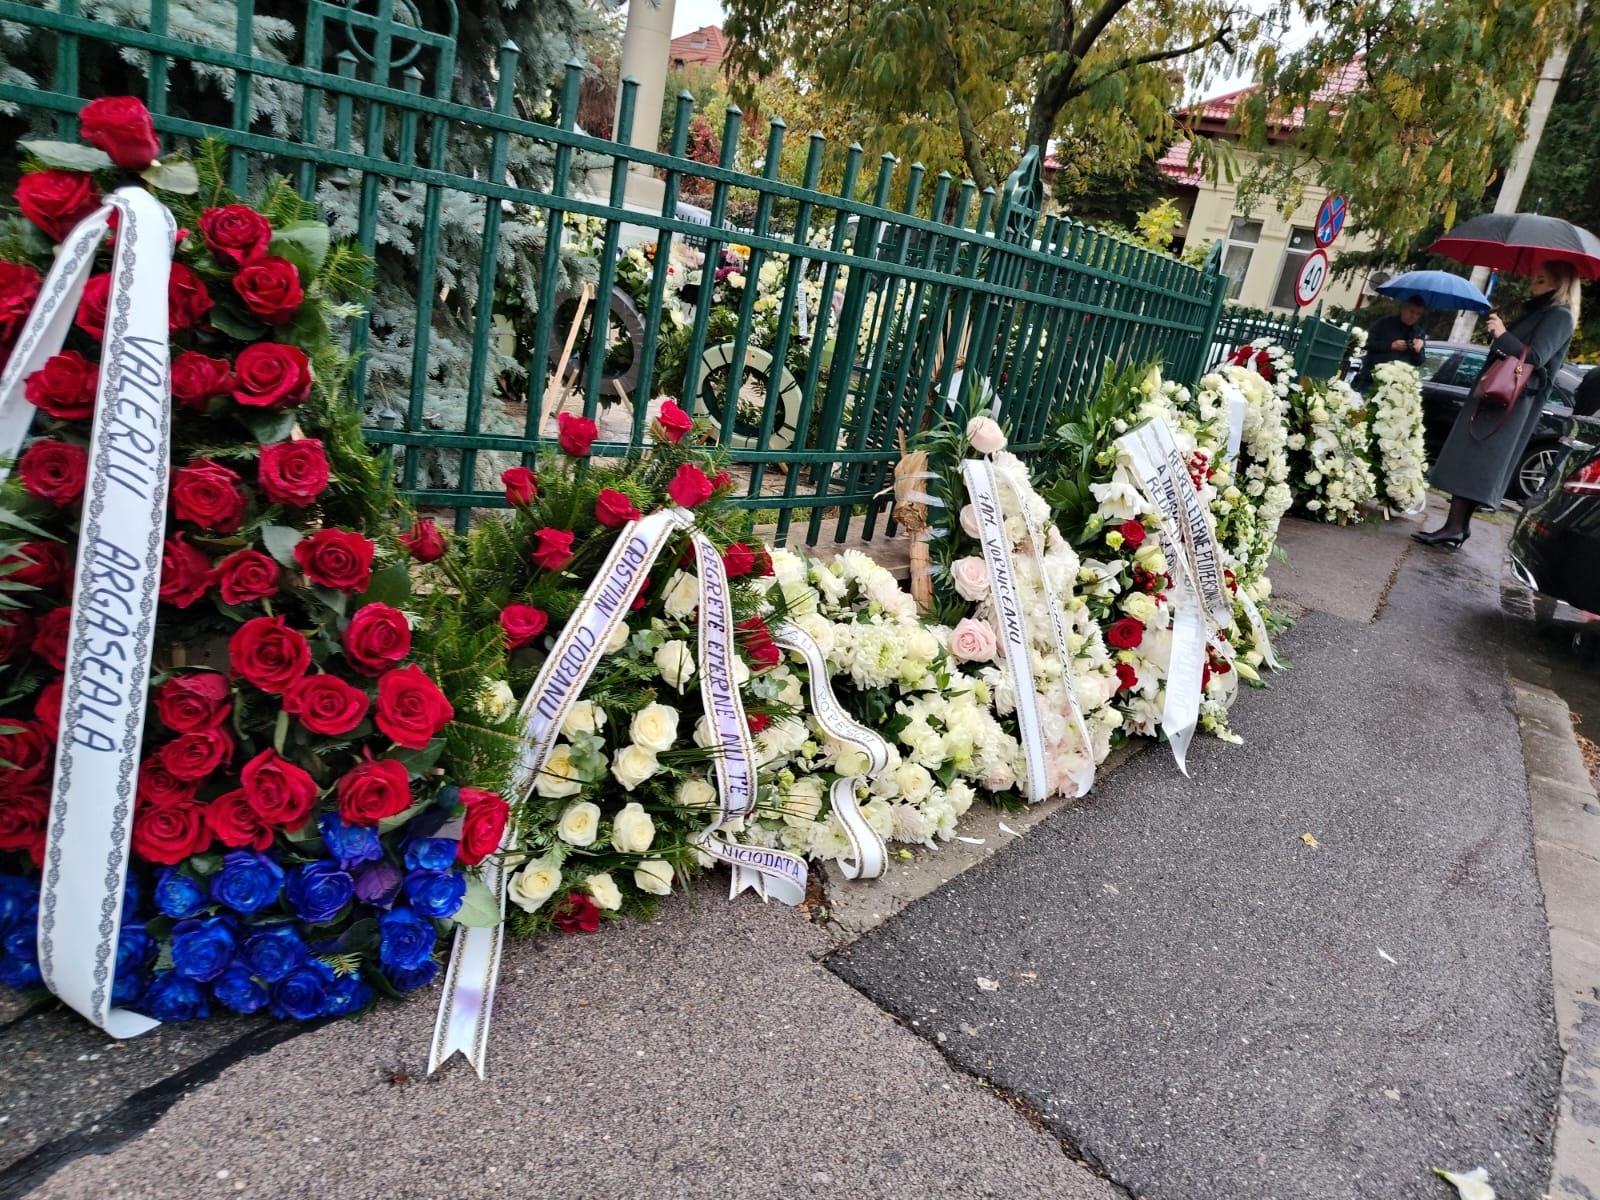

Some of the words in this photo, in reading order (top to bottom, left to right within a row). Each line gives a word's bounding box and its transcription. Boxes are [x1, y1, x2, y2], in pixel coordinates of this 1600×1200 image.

[1304, 264, 1322, 291] 40
[107, 335, 164, 500] VALERIU
[594, 537, 648, 618] CRISTIAN
[701, 541, 725, 633] REGRETE
[537, 625, 596, 720] CIOBANU
[708, 640, 735, 720] ETERNE
[722, 733, 739, 764] NU
[730, 771, 749, 798] TE
[721, 845, 800, 879] NICIODATA
